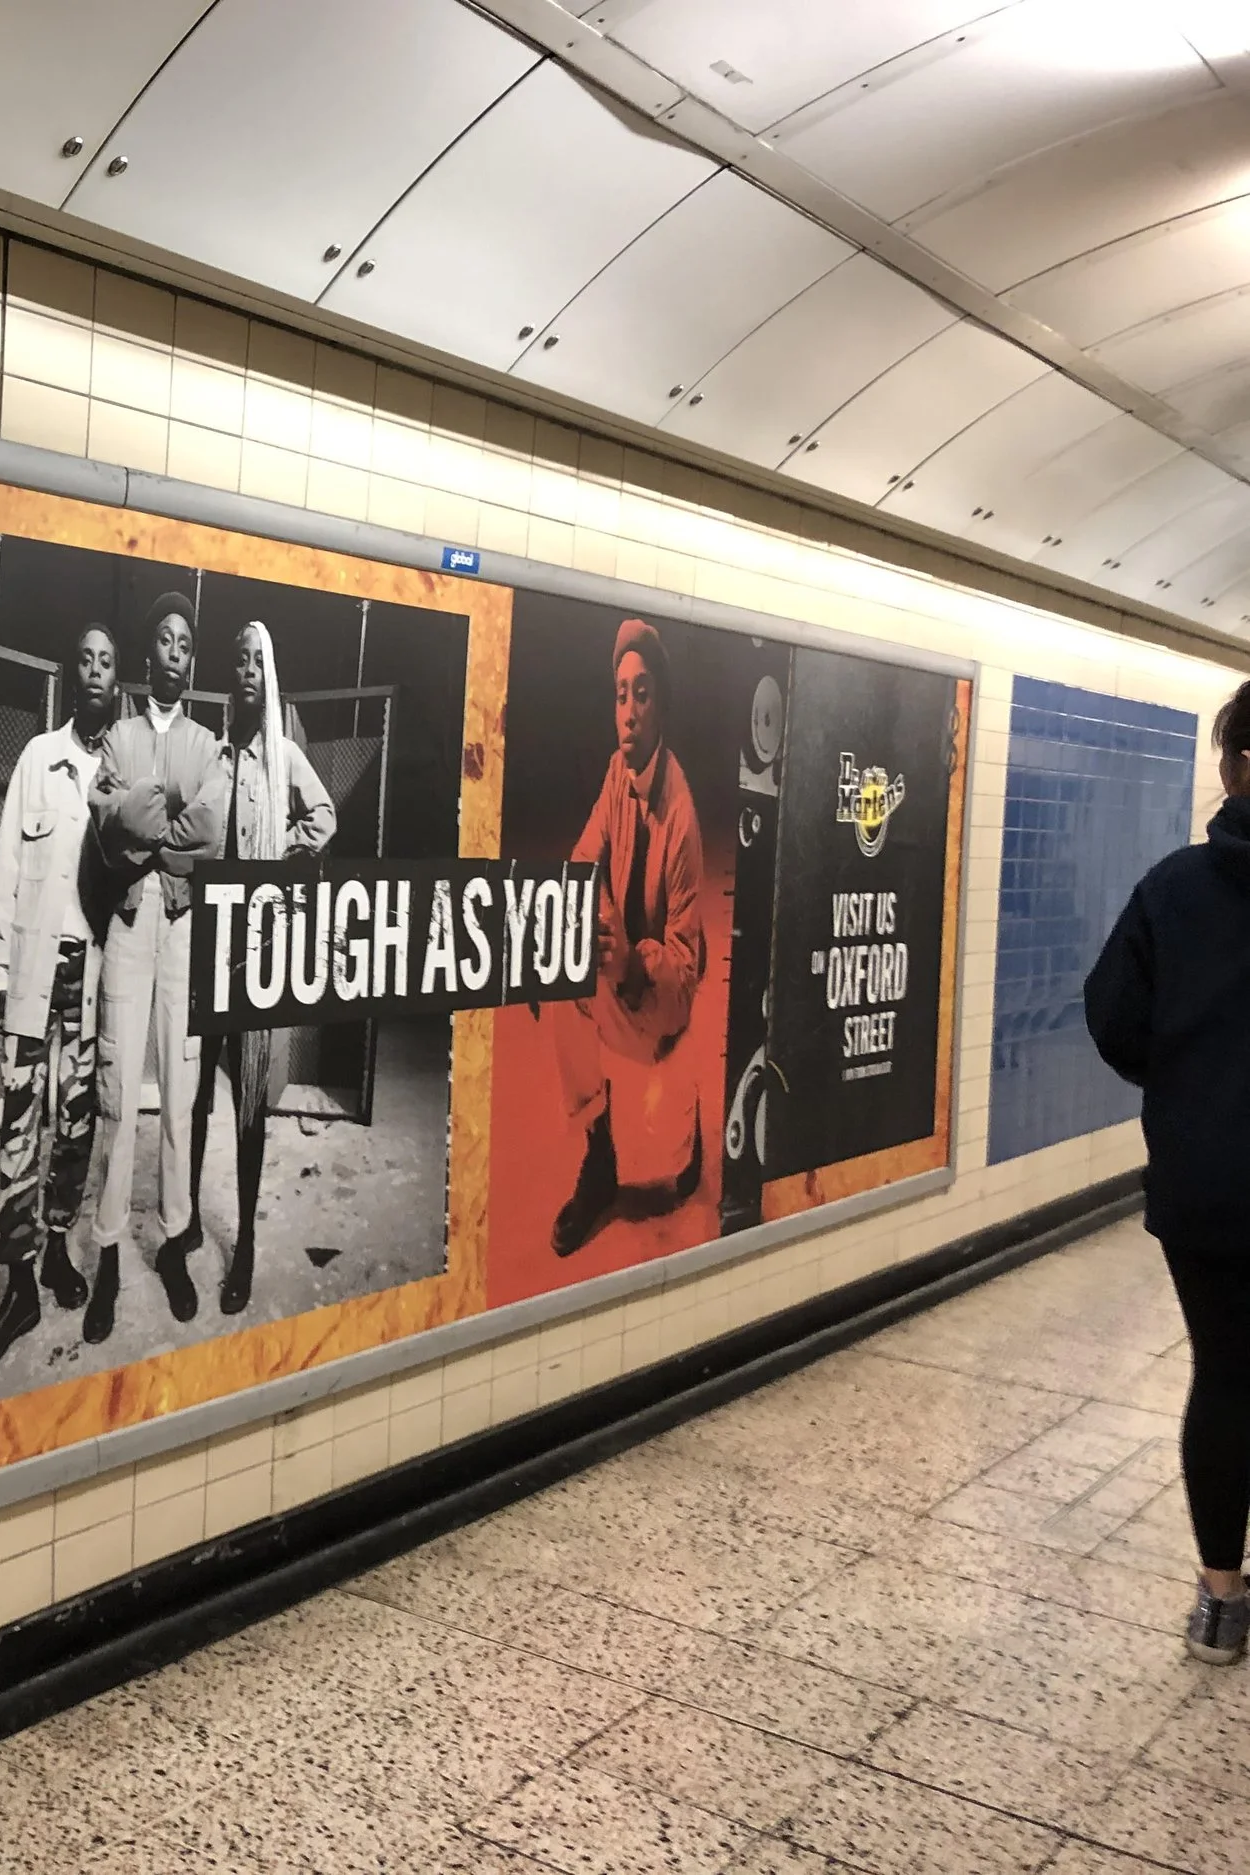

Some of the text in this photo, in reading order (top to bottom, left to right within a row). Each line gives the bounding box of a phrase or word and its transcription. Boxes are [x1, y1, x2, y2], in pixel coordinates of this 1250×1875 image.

[450, 551, 474, 568] global
[833, 892, 897, 937] VISIT US
[204, 877, 594, 1012] TOUGH AS YOU
[827, 942, 908, 1009] OXFORD
[843, 1011, 897, 1058] STREET
